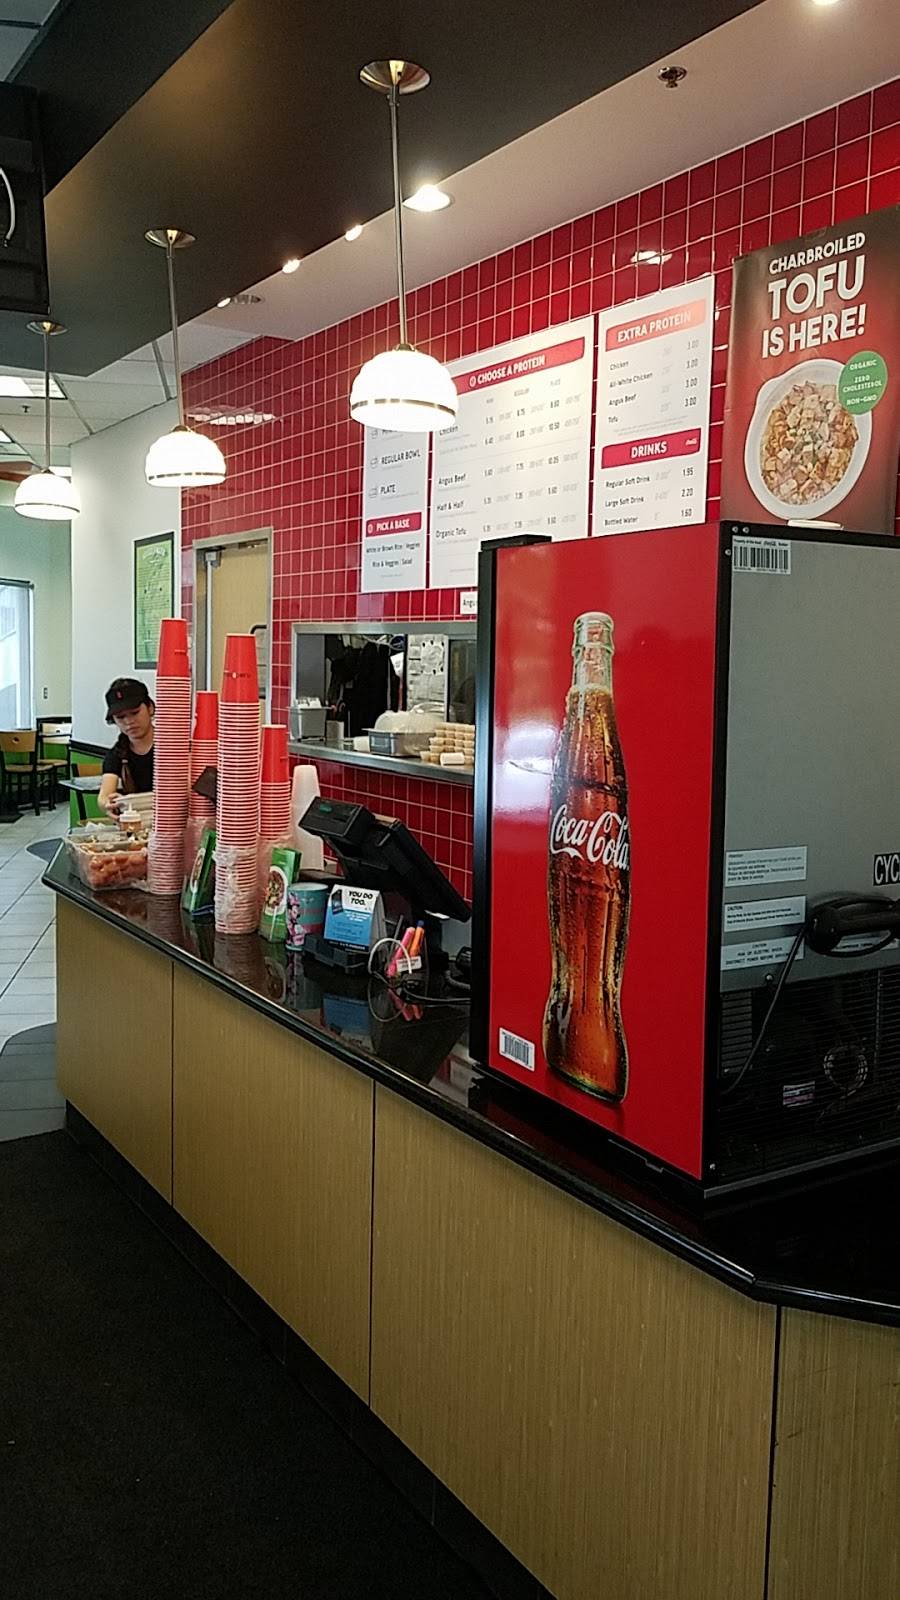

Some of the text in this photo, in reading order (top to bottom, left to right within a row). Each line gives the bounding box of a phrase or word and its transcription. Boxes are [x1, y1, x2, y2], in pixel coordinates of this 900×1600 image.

[769, 231, 866, 275] CHARBROILED
[768, 254, 866, 320] TOFU
[617, 310, 691, 343] EXTRA PROTEIN
[762, 303, 867, 359] IS HERE!
[477, 354, 546, 385] CHOOSE A PROTEIN
[849, 359, 877, 371] ORGANIC
[854, 374, 871, 384] ZERO
[846, 394, 877, 406] NON-GMO
[631, 440, 668, 459] DRINKS
[381, 452, 405, 466] REGULAR
[380, 484, 396, 495] PLATE
[375, 521, 388, 532] PICK
[394, 518, 410, 529] BASE
[550, 804, 629, 870] Coca-Cola
[875, 853, 900, 885] CYC
[348, 891, 373, 900] YOU DO
[350, 897, 366, 906] TOO.
